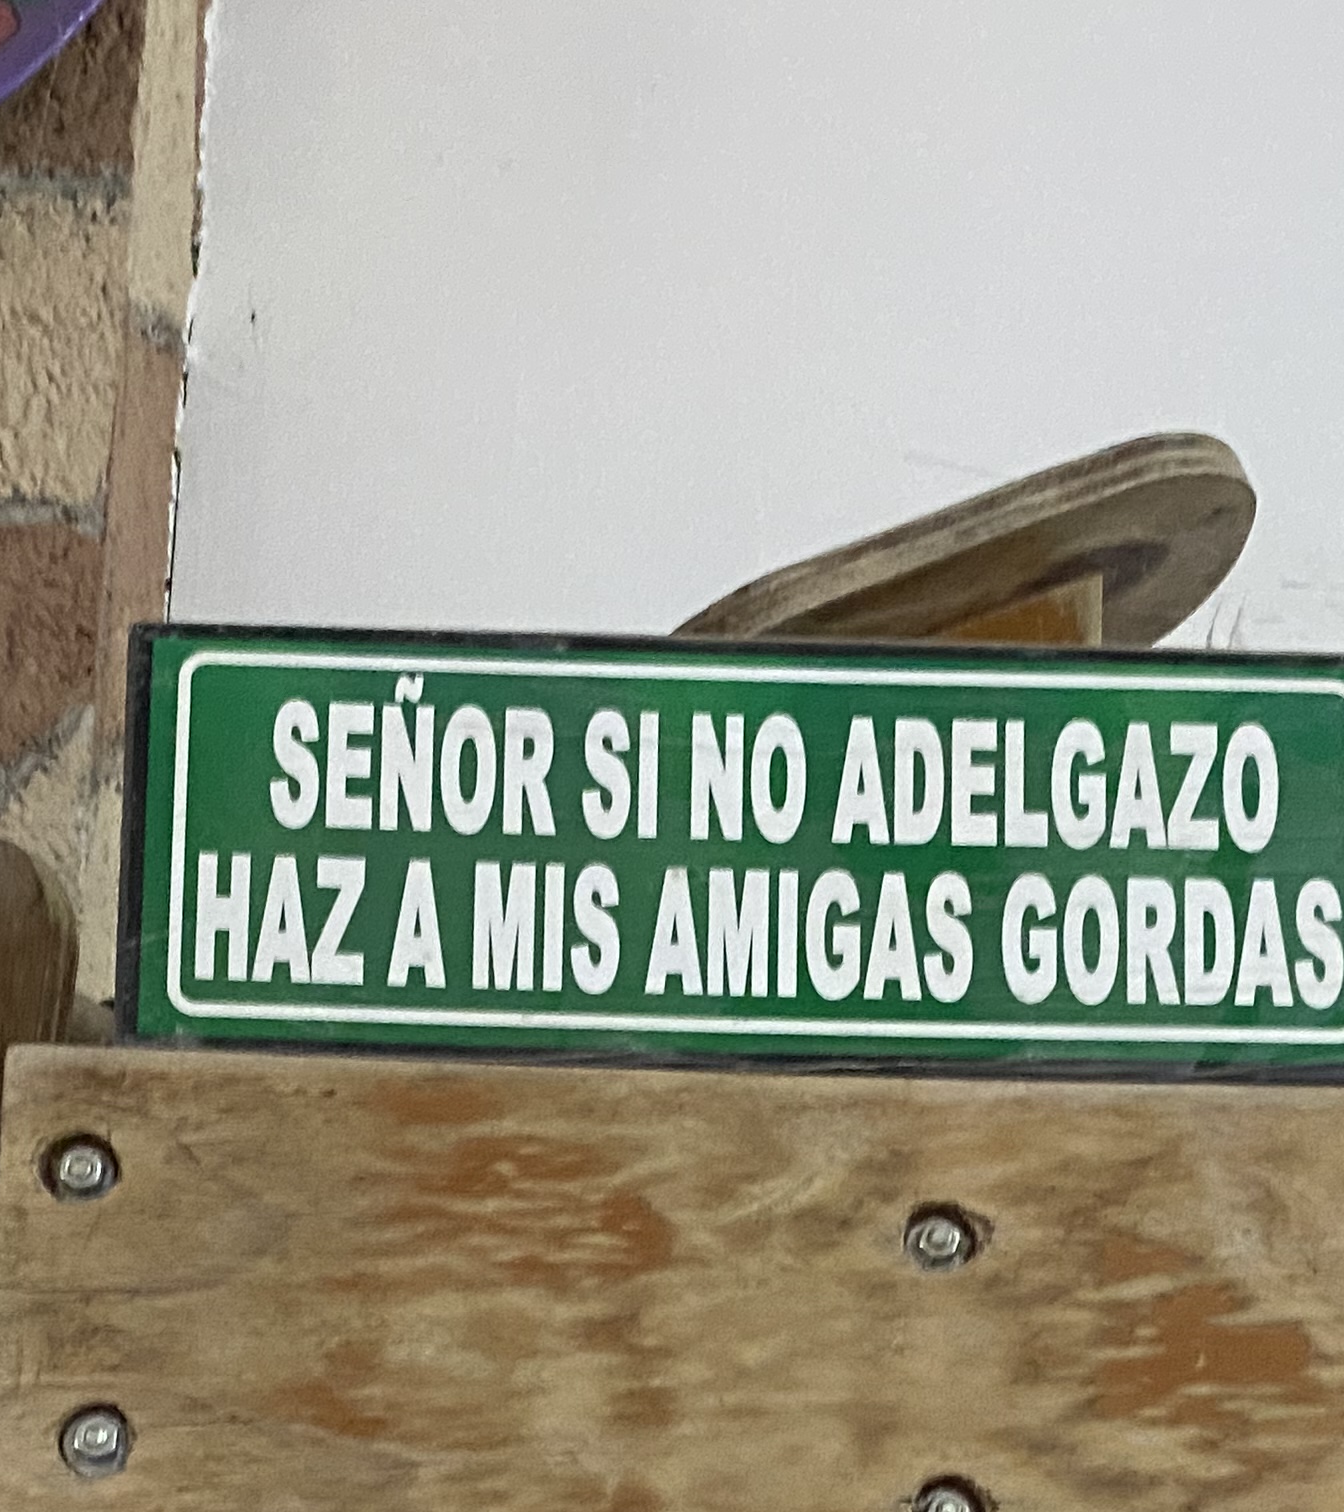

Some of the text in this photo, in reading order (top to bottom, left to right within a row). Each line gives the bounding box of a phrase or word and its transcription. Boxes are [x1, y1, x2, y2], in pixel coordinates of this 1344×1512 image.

[269, 672, 1279, 854] SEÑOR SI NO ADELGAZO
[192, 851, 1344, 1012] HAZ A MIS AMIGAS GORDAS
